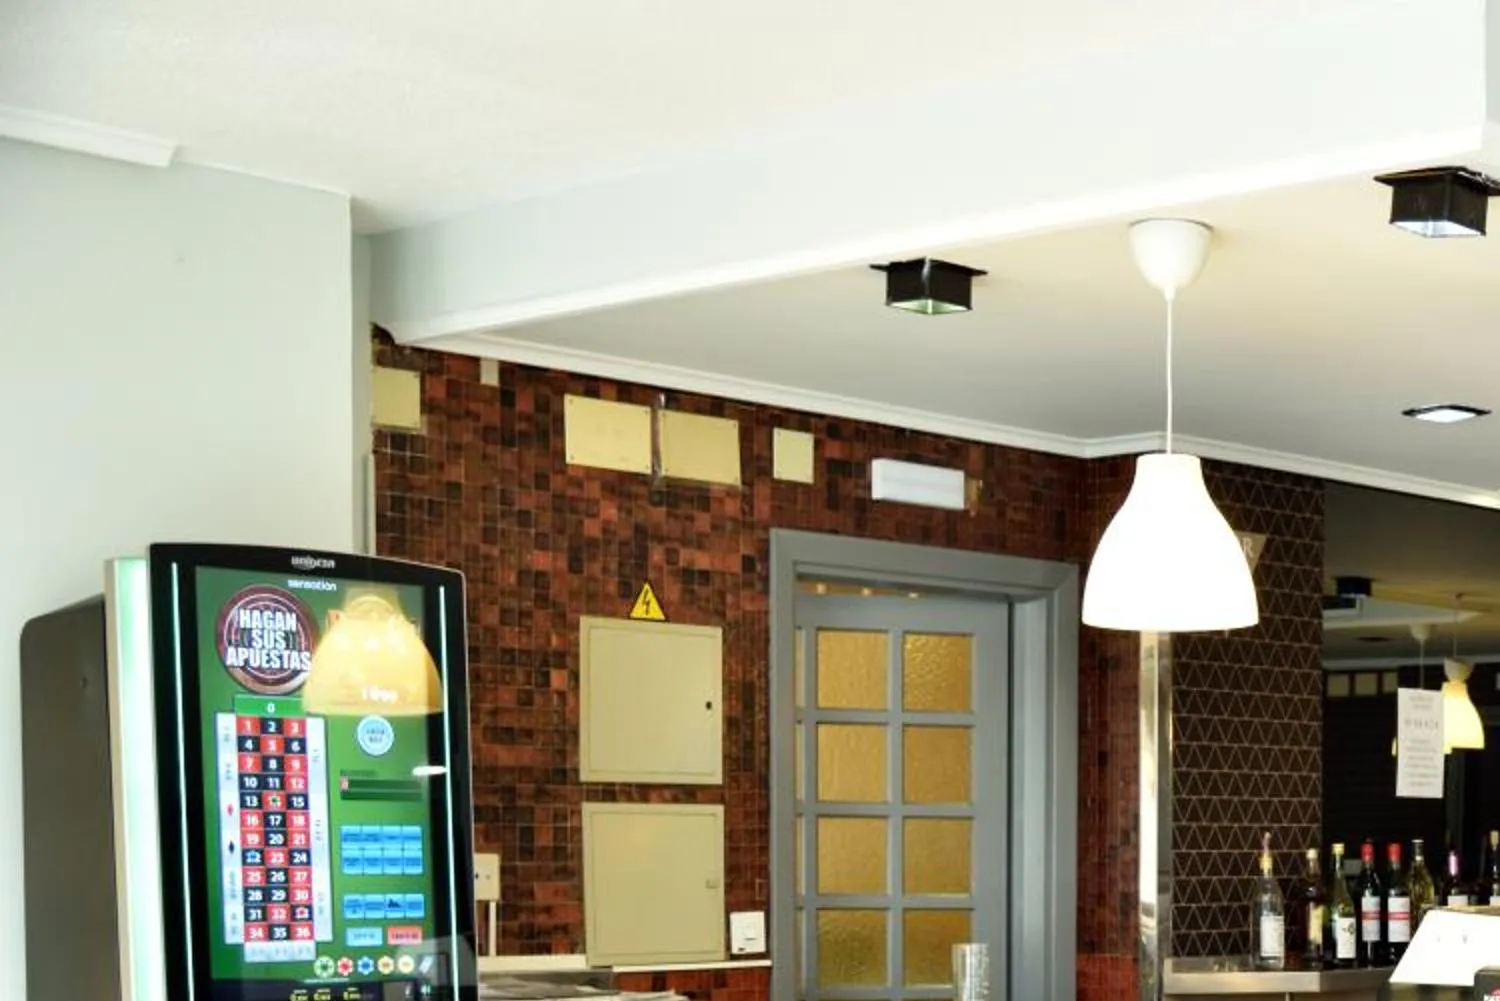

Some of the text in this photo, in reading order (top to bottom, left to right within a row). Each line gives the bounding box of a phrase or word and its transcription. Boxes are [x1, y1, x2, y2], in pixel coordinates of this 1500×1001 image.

[239, 609, 297, 631] HAGAN
[251, 629, 286, 650] SUS
[226, 646, 312, 670] APUESTAS
[266, 702, 275, 713] 0
[267, 721, 277, 732] 2
[245, 739, 254, 750] 4
[291, 741, 301, 752] 6
[268, 758, 278, 770] 8
[291, 759, 301, 771] 9
[243, 777, 305, 790] 10 11 12
[244, 796, 259, 808] 13
[291, 796, 305, 808] 15
[268, 815, 283, 826] 17
[268, 834, 284, 846] 20
[292, 834, 306, 845] 21
[270, 853, 285, 864] 23
[292, 852, 308, 863] 24
[246, 870, 308, 883] 25 26 27
[247, 889, 309, 902] 28 29 30
[249, 908, 262, 921] 31
[270, 908, 287, 919] 32
[248, 927, 265, 939] 34
[273, 927, 288, 939] 35
